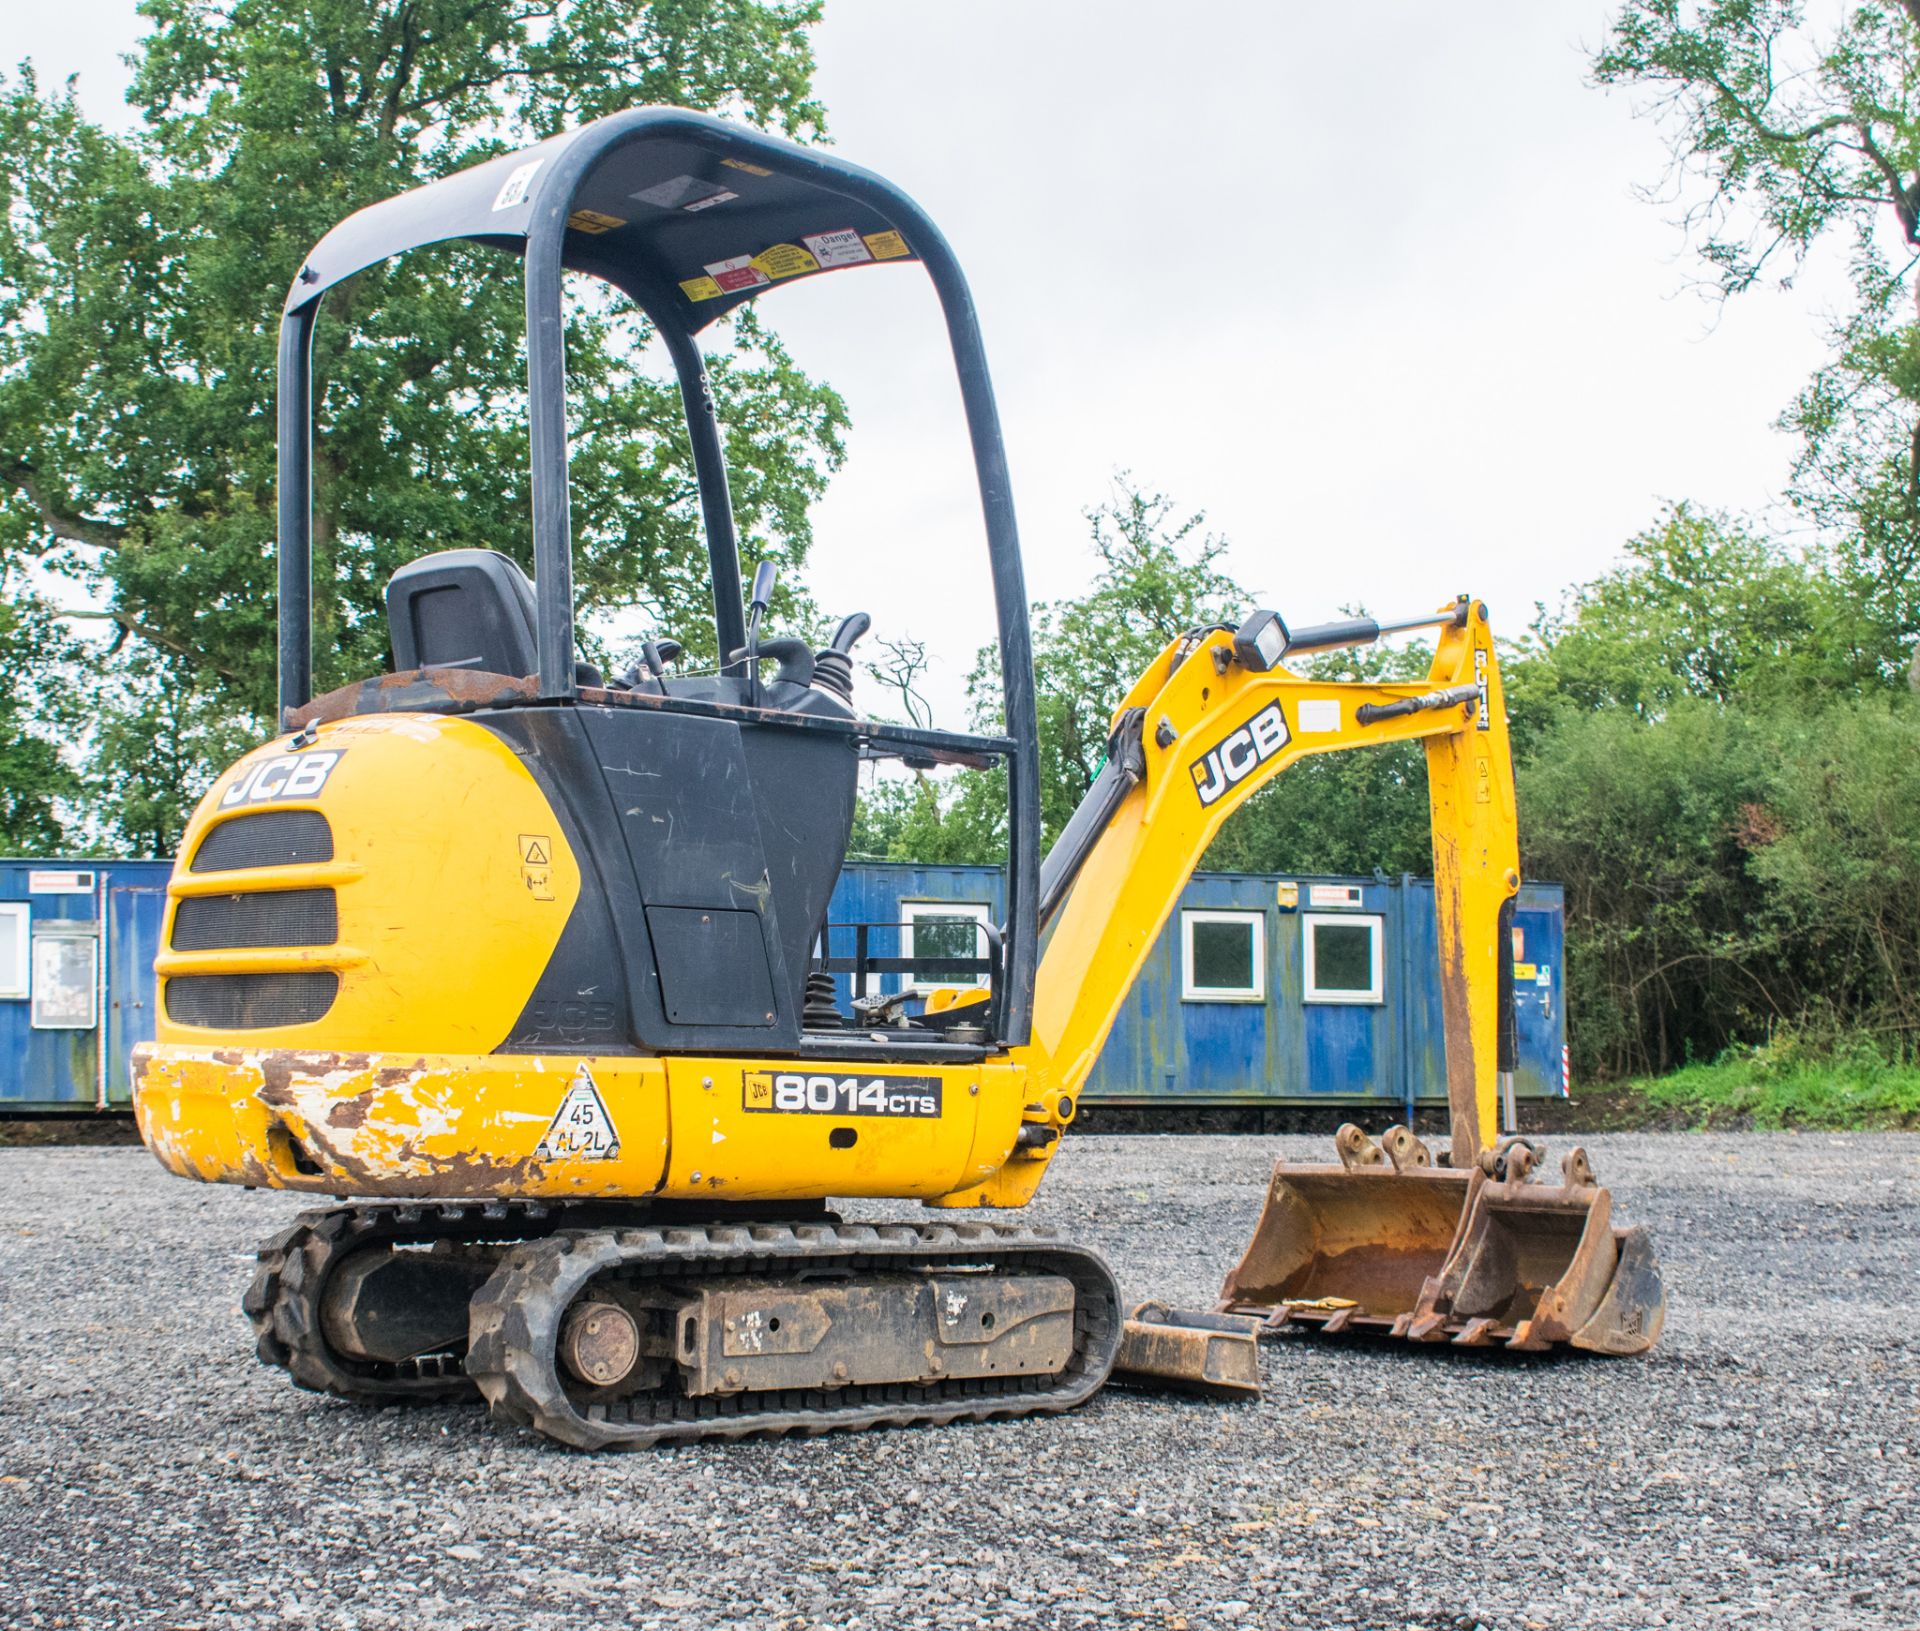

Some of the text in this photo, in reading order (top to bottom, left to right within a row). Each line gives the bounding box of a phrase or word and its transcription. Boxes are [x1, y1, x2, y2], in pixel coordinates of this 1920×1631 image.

[821, 231, 857, 245] Danger
[1199, 706, 1288, 803] JCB
[222, 752, 338, 805] JCB
[752, 1083, 768, 1099] JCB
[571, 1104, 594, 1125] 45
